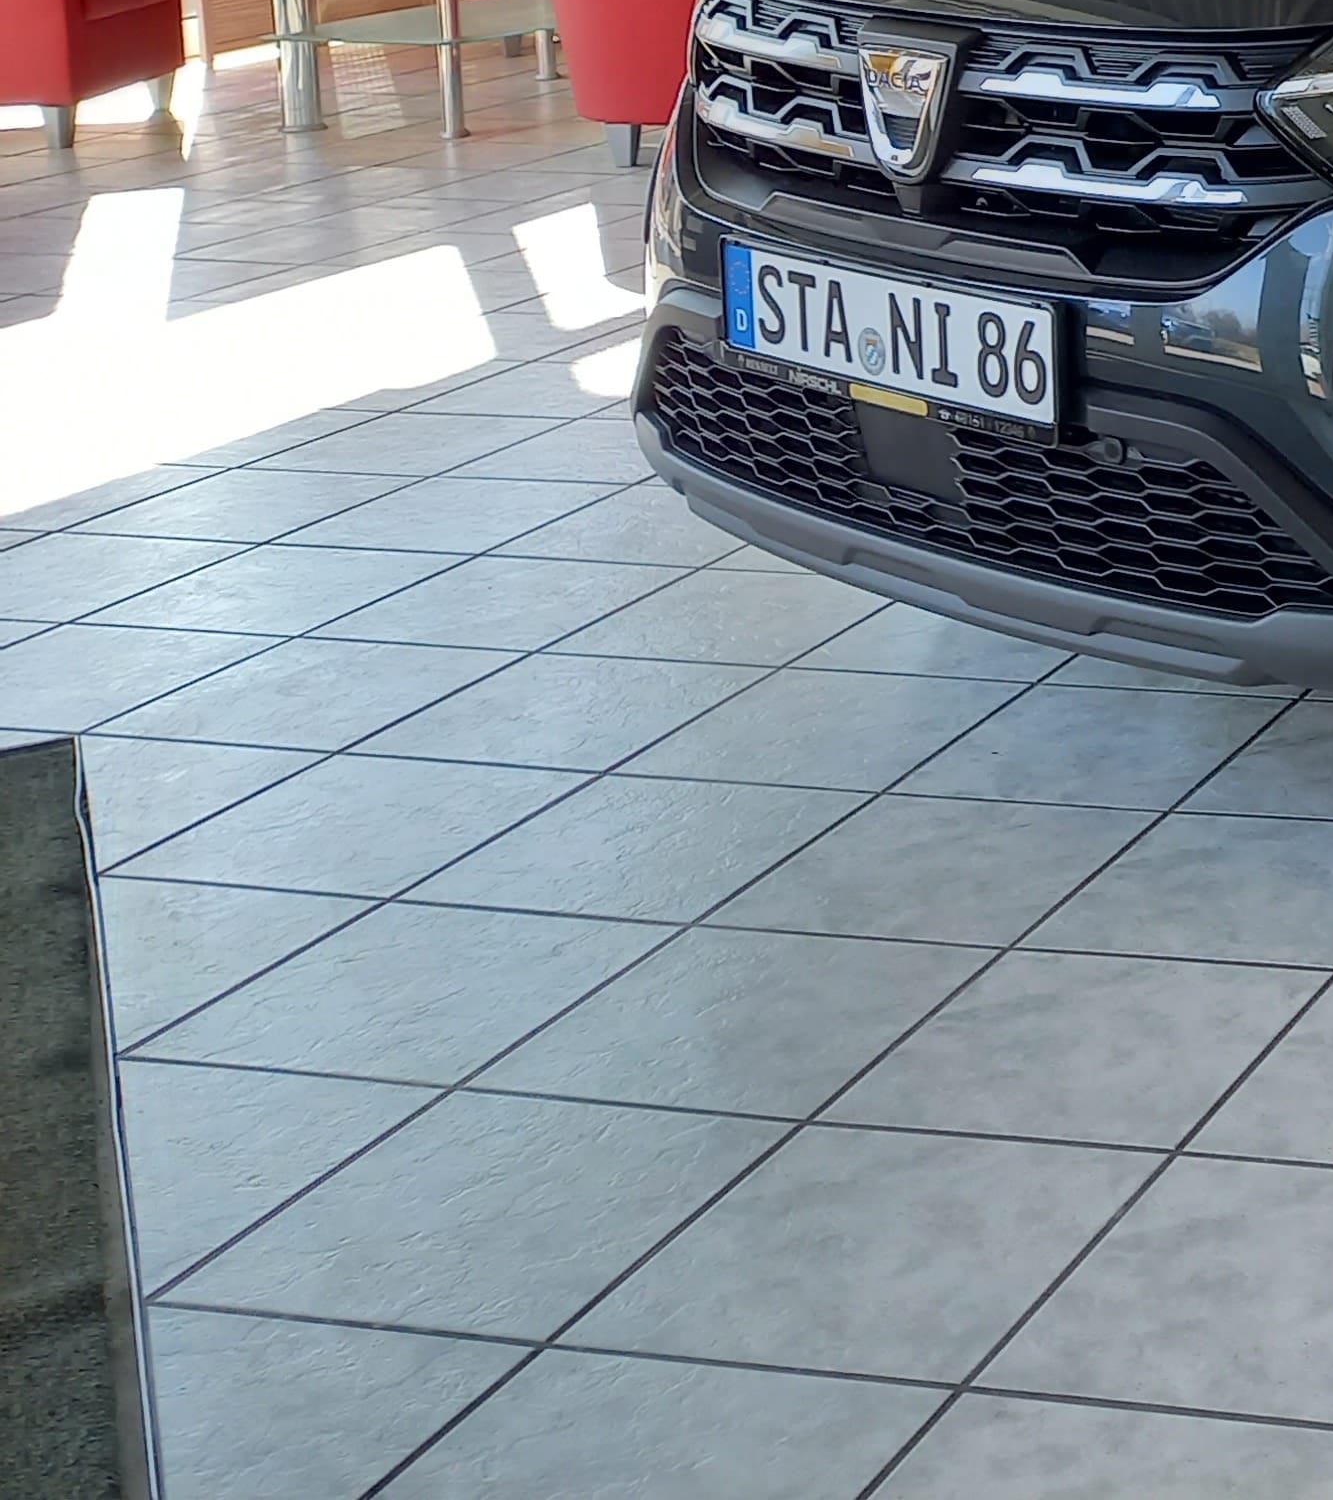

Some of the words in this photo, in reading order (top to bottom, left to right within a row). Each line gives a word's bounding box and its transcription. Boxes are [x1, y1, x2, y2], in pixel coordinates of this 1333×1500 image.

[866, 67, 924, 92] DACIA
[736, 308, 748, 331] D
[757, 264, 852, 363] STA
[888, 292, 958, 389] NI
[977, 311, 1046, 405] 86
